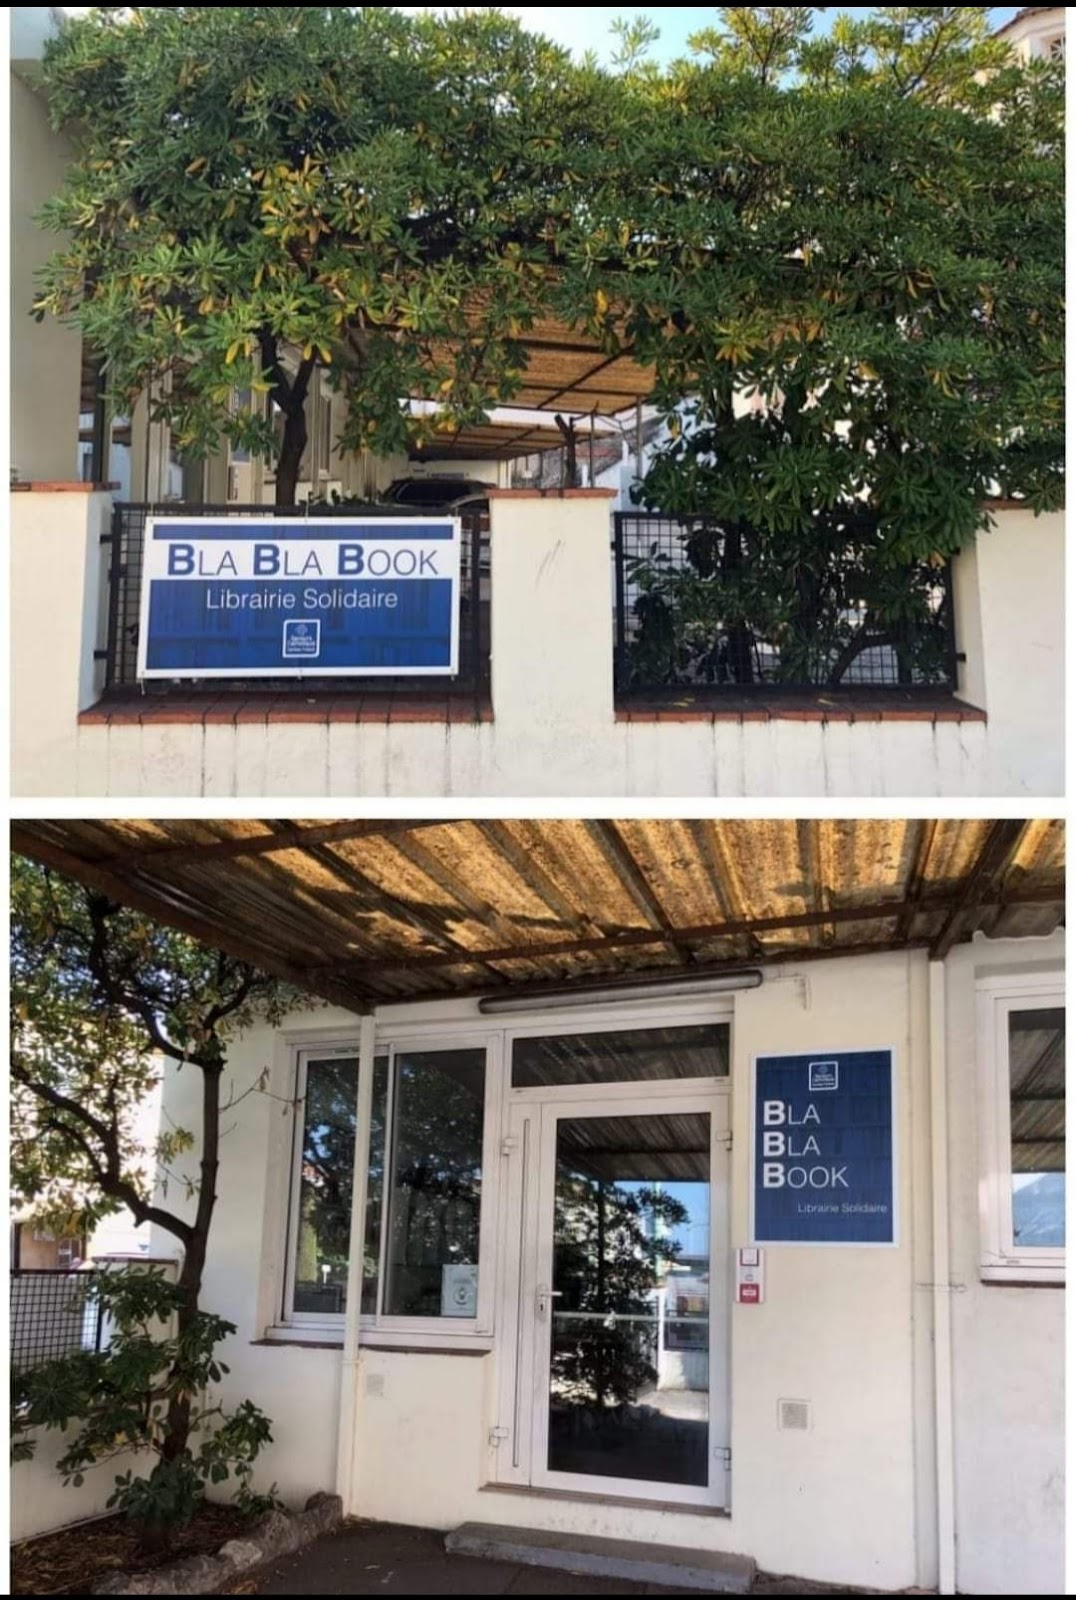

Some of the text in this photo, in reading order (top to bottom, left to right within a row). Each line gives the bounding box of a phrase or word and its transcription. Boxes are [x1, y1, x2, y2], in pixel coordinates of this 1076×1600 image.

[167, 543, 438, 576] BLA BLA BOOK
[206, 587, 398, 609] Librairie Solidaire
[763, 1100, 821, 1126] BLA
[763, 1131, 821, 1157] BLA
[763, 1162, 849, 1189] BOOK
[798, 1202, 888, 1213] Librairie Solidaire
